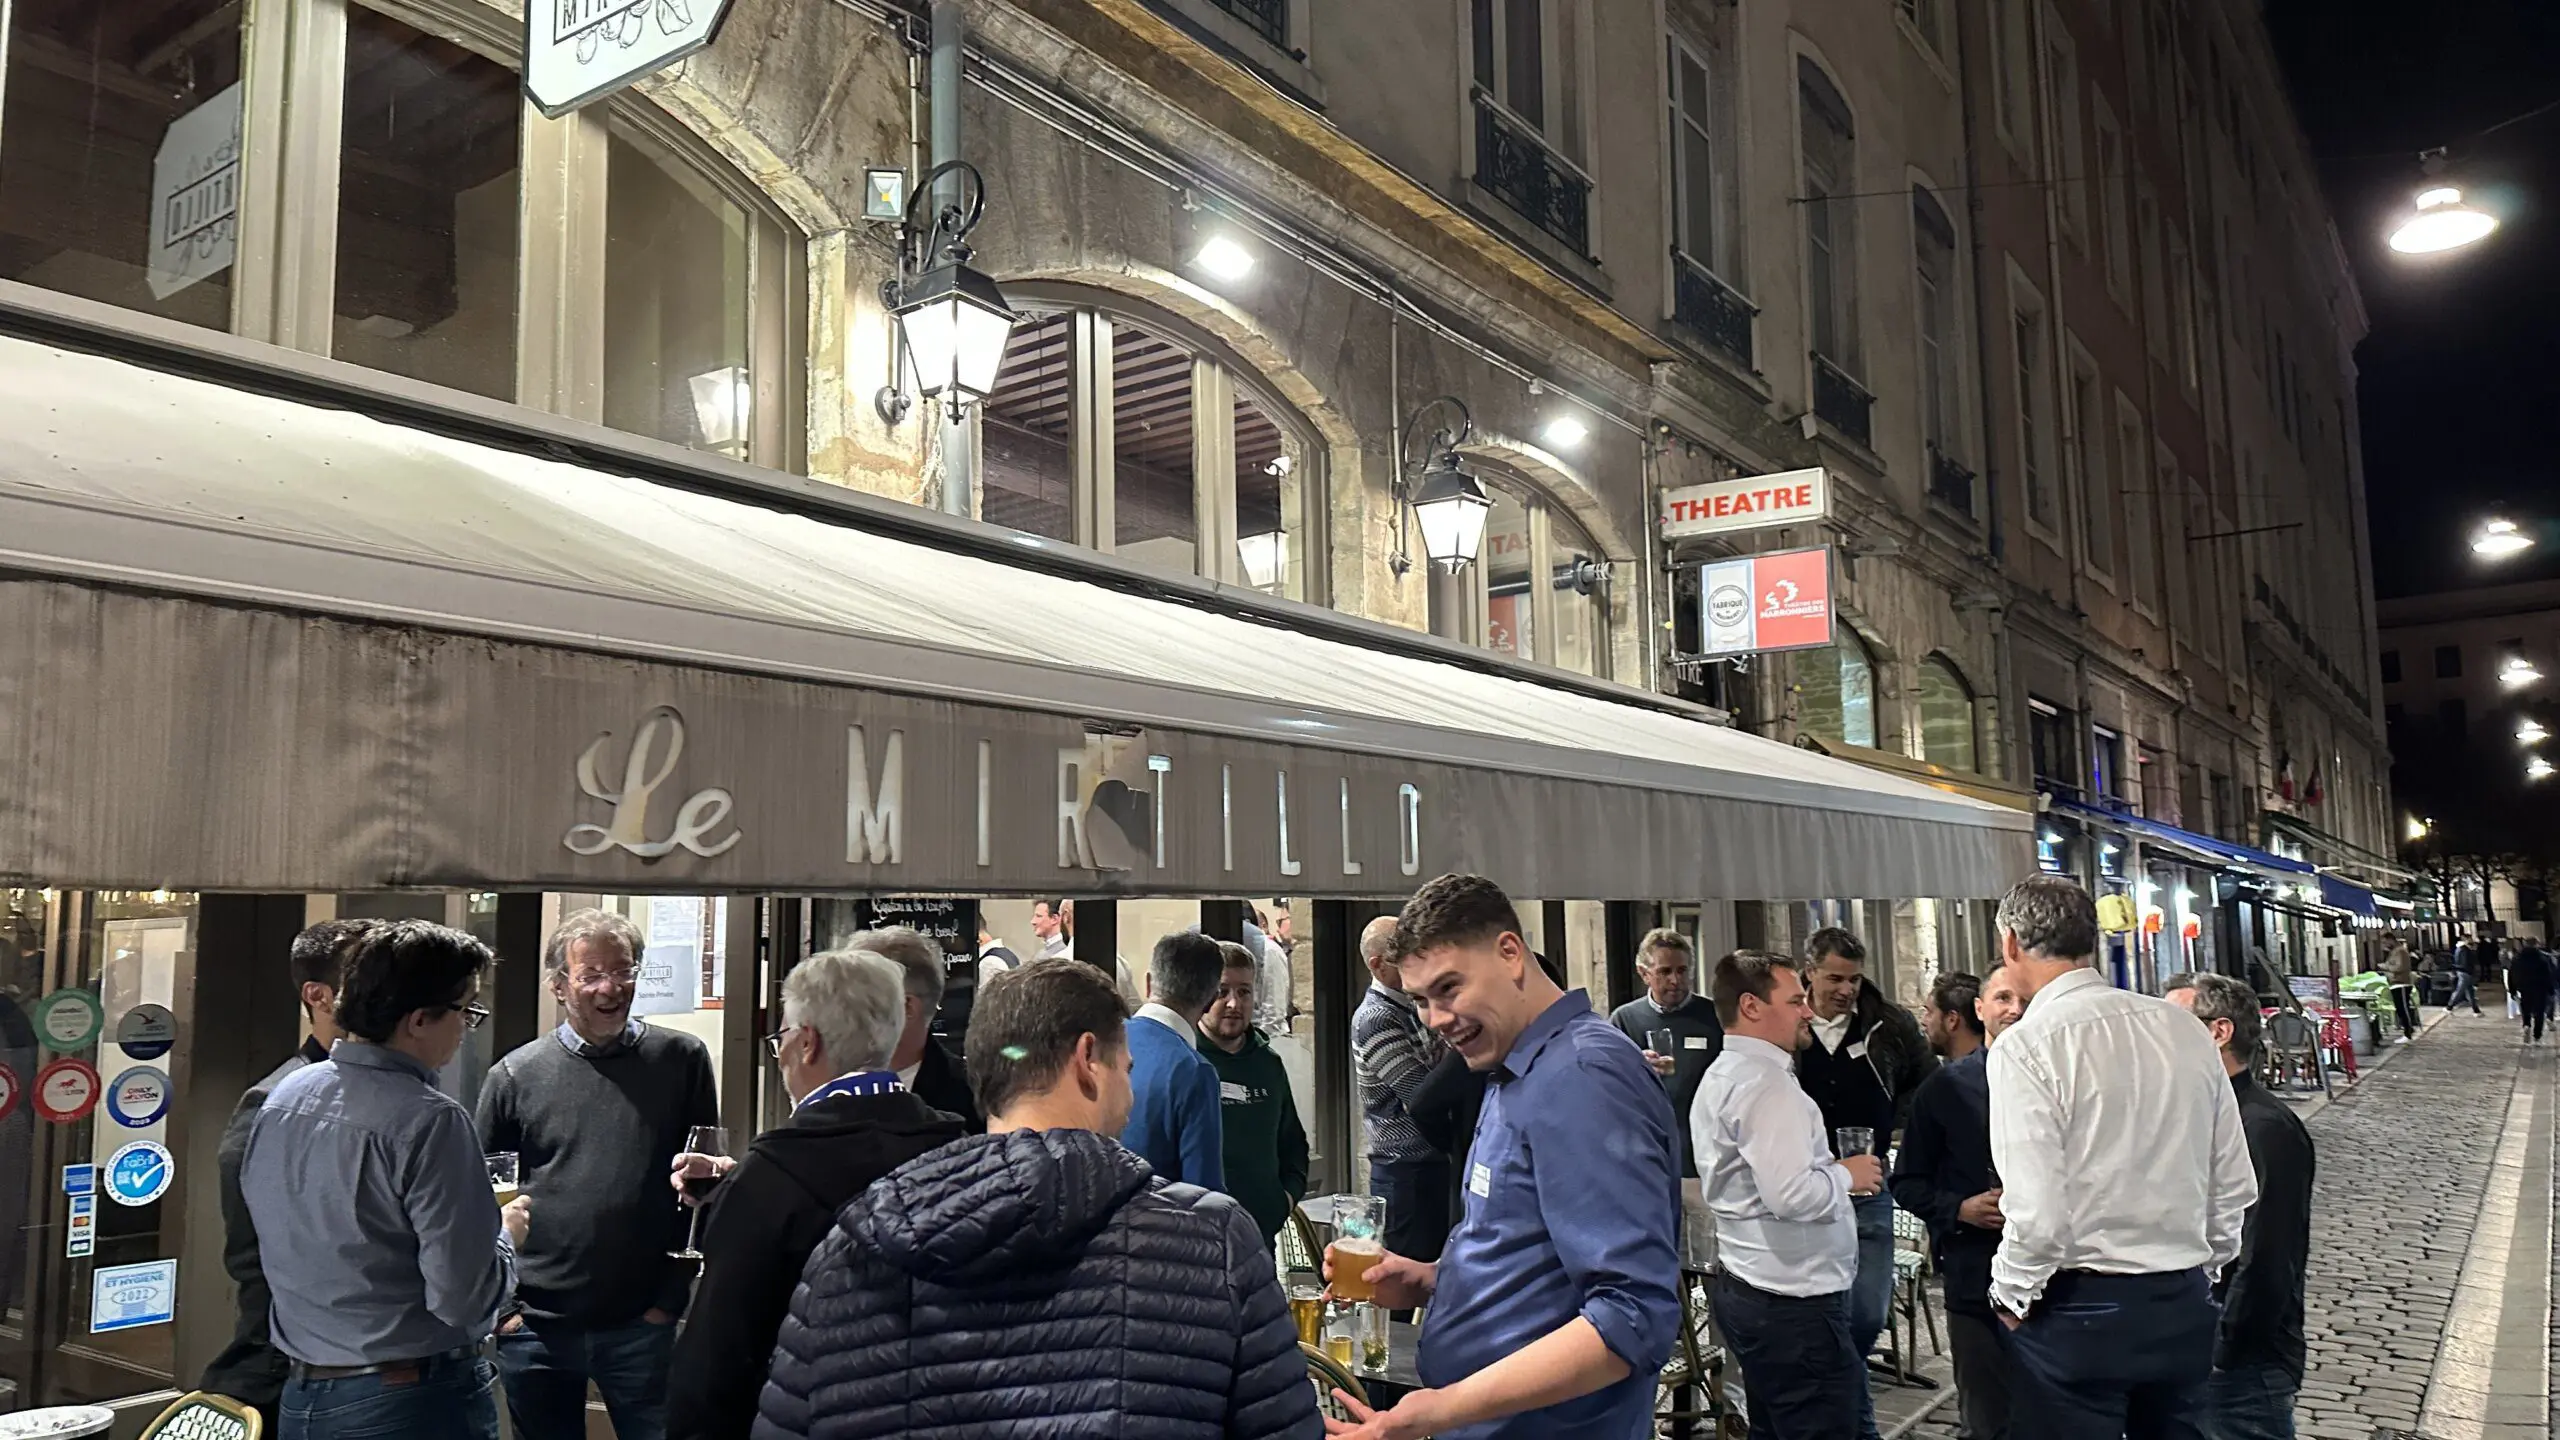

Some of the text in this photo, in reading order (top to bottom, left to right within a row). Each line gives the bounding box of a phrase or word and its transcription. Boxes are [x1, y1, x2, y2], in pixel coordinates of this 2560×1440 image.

[1670, 483, 1812, 522] THEATRE
[1759, 604, 1825, 619] MARRONNIERS
[562, 704, 1422, 876] Le MIRTILLO
[120, 1288, 149, 1303] 2022
